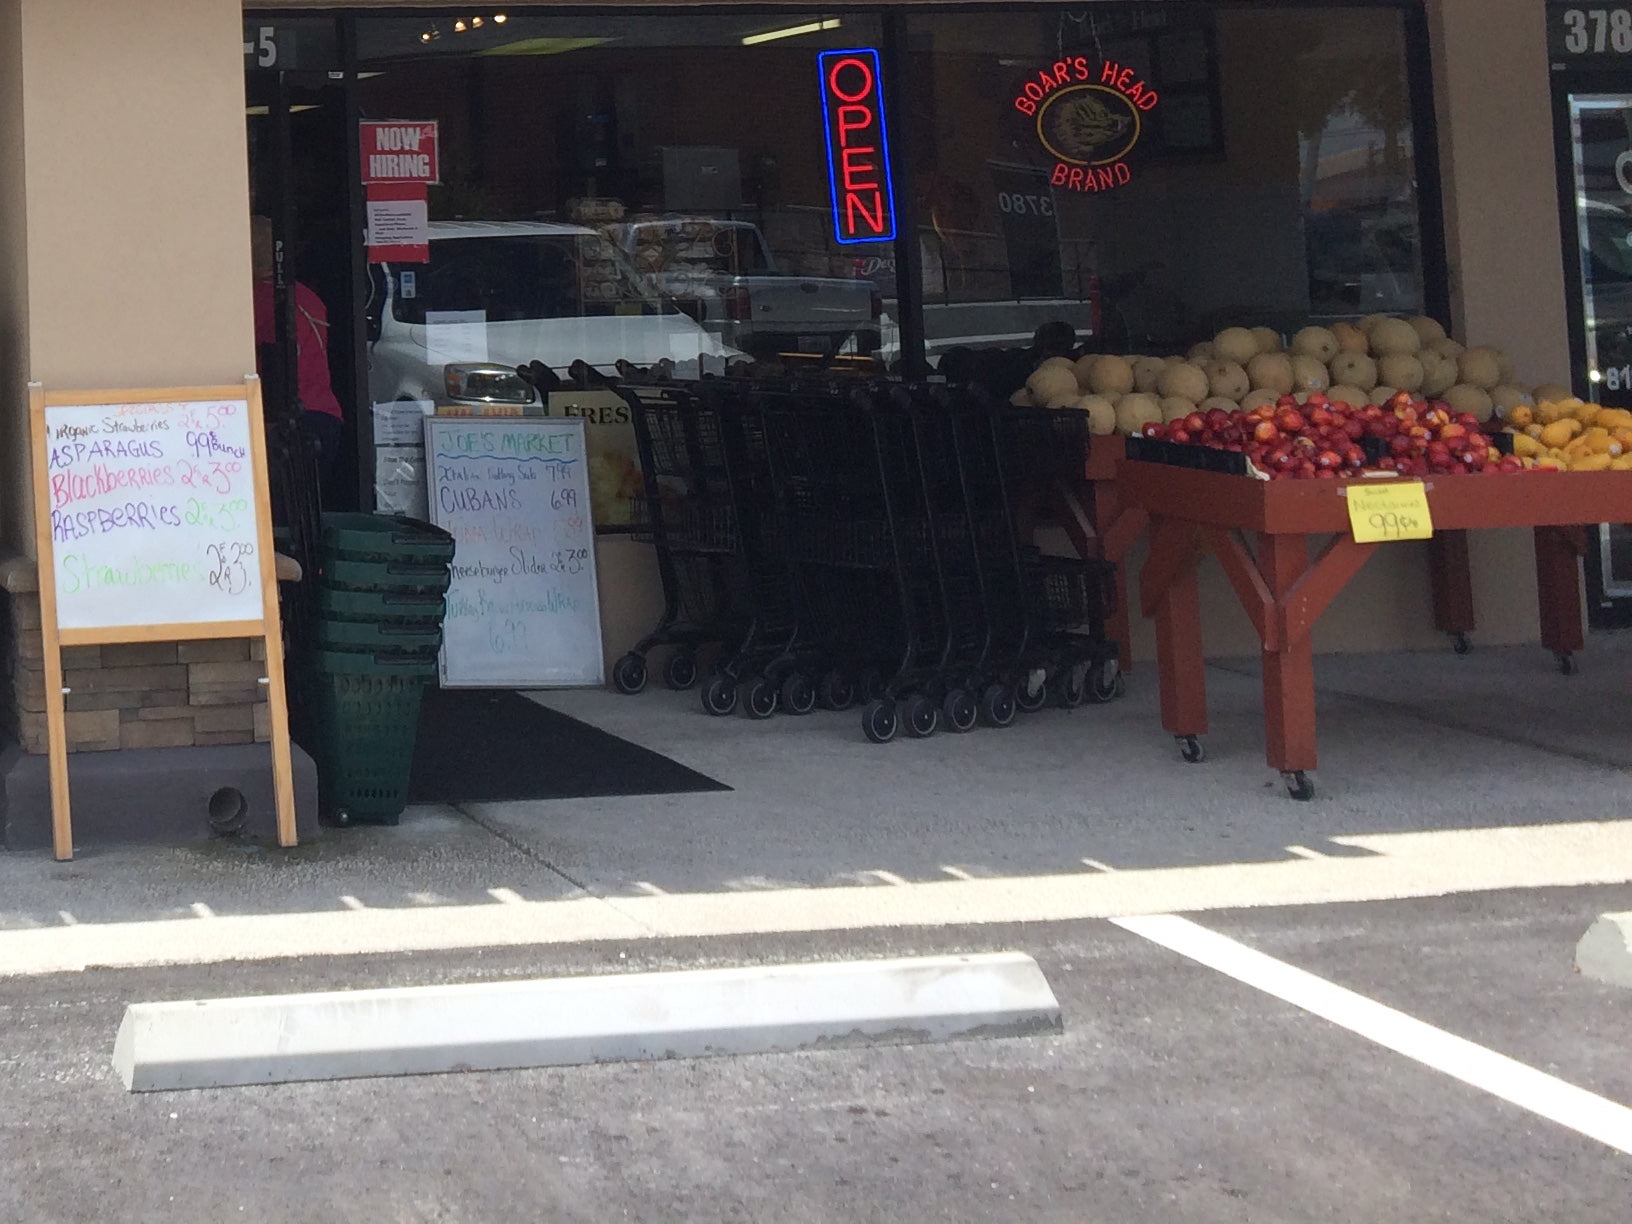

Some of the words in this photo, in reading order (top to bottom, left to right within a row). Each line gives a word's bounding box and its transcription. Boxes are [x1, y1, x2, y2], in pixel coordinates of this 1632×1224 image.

[1015, 56, 1089, 117] BOAR'S
[1100, 60, 1159, 112] HEAD
[376, 127, 421, 152] NOW
[829, 58, 884, 235] OPEN
[369, 154, 431, 178] HIRING
[1050, 162, 1131, 193] BRAND
[48, 439, 164, 470] ASPARAGUS
[439, 430, 495, 454] JOE'S
[501, 432, 575, 456] MARKET
[440, 487, 522, 514] CUBANS
